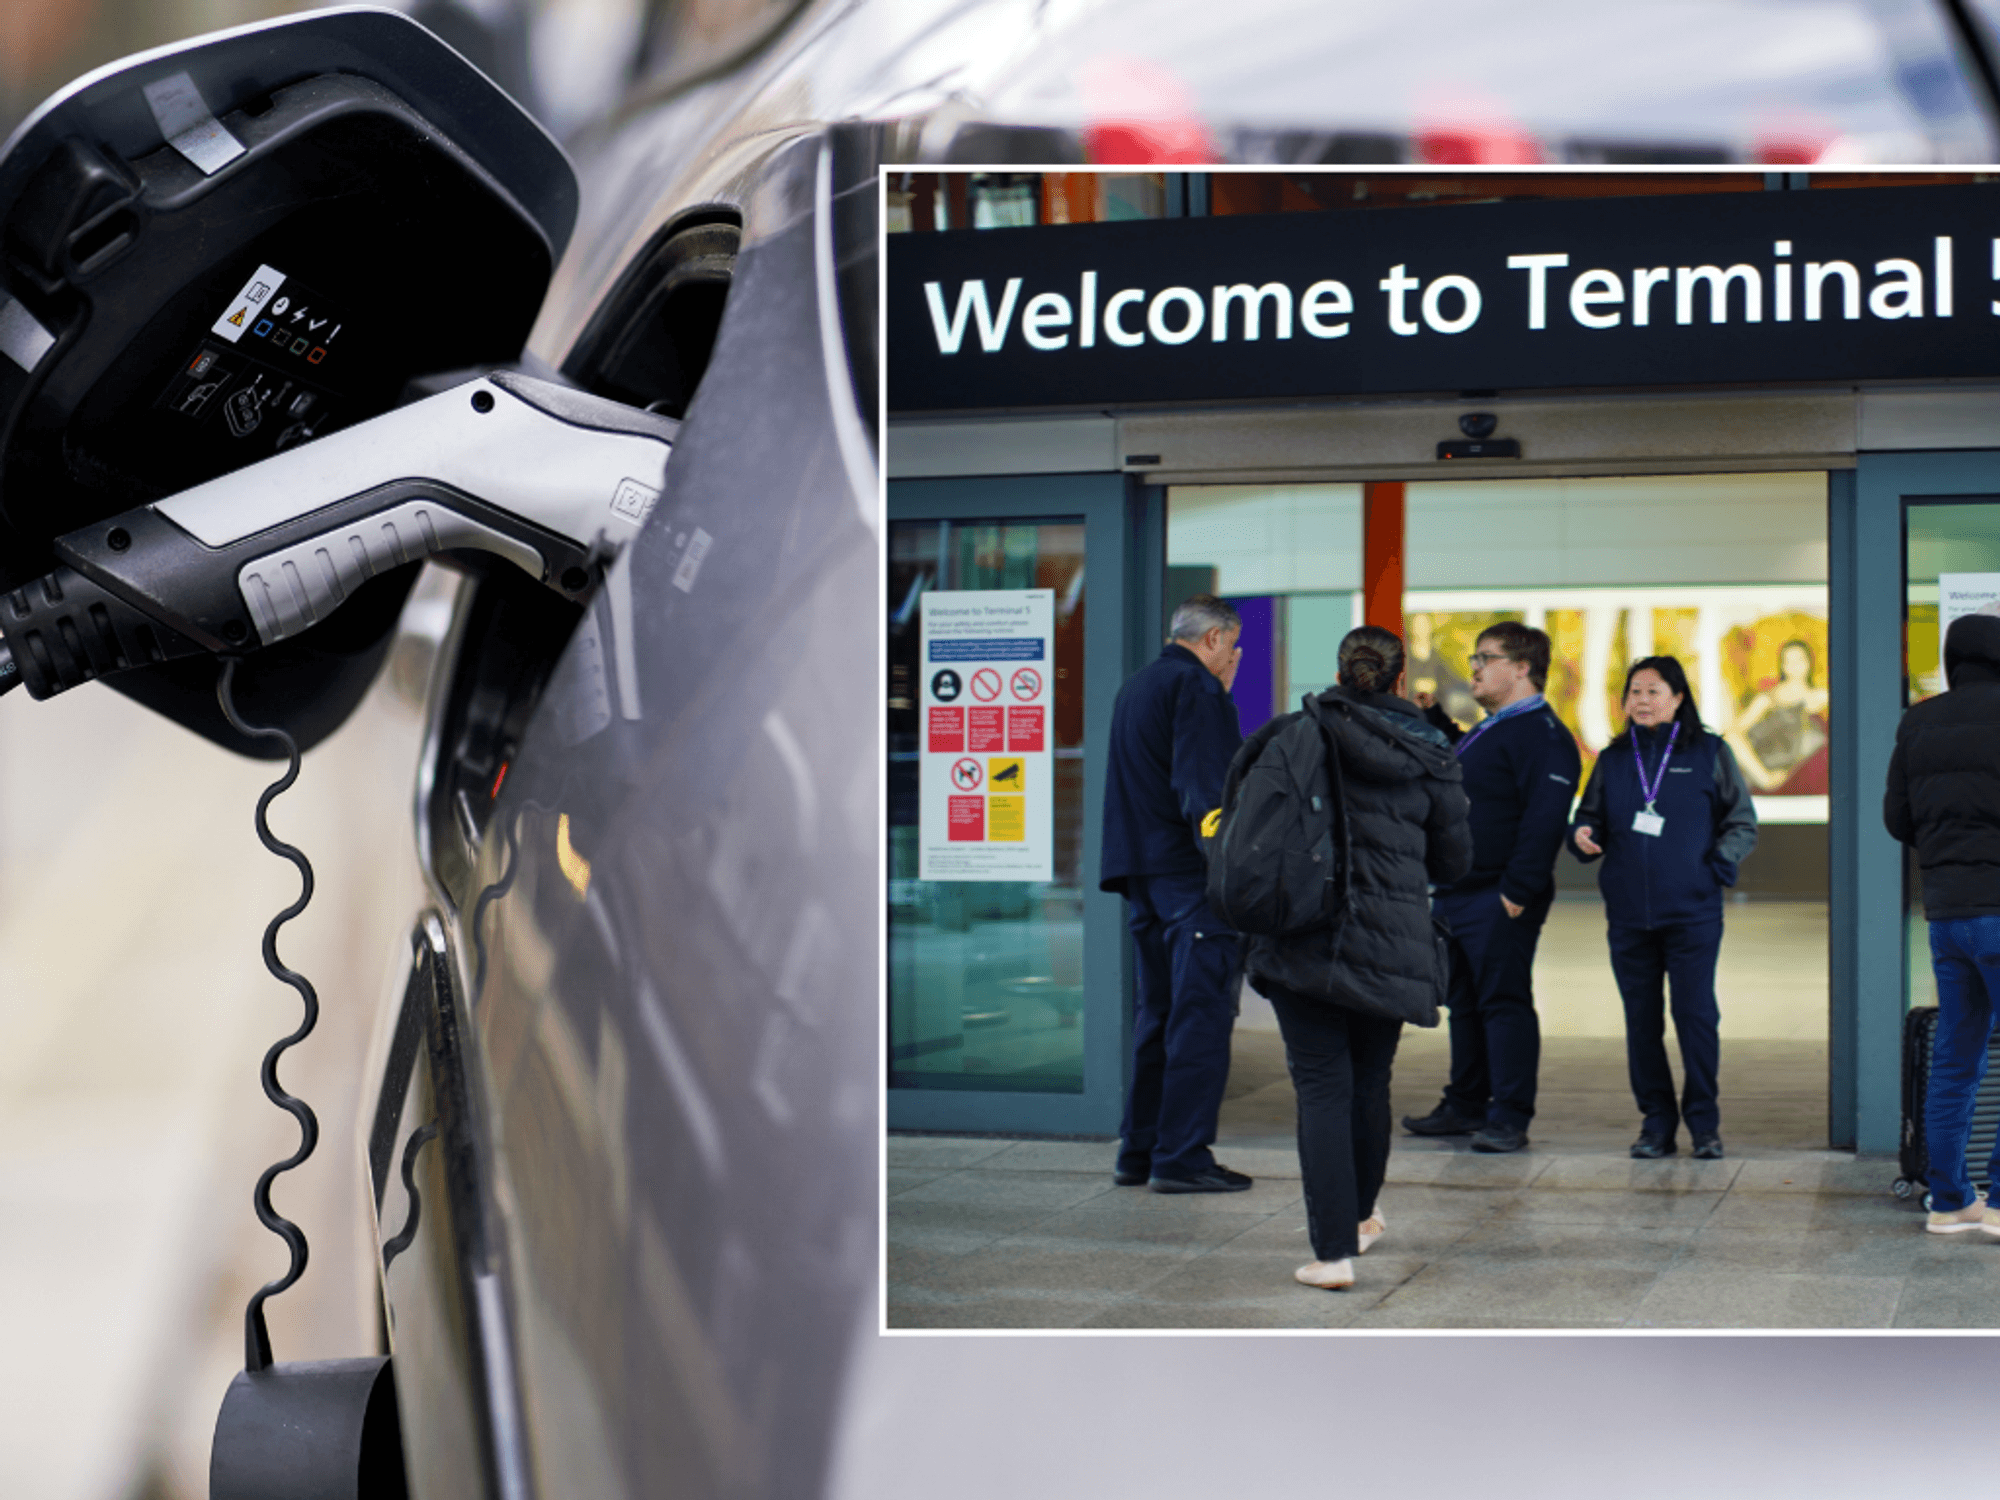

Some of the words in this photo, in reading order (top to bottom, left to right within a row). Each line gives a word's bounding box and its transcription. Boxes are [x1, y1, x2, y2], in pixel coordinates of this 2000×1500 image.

[924, 270, 1354, 354] Welcome
[1379, 263, 1482, 336] to
[1507, 236, 1953, 330] Terminal
[928, 607, 970, 616] Welcome
[972, 607, 982, 615] to
[984, 606, 1022, 615] Terminal
